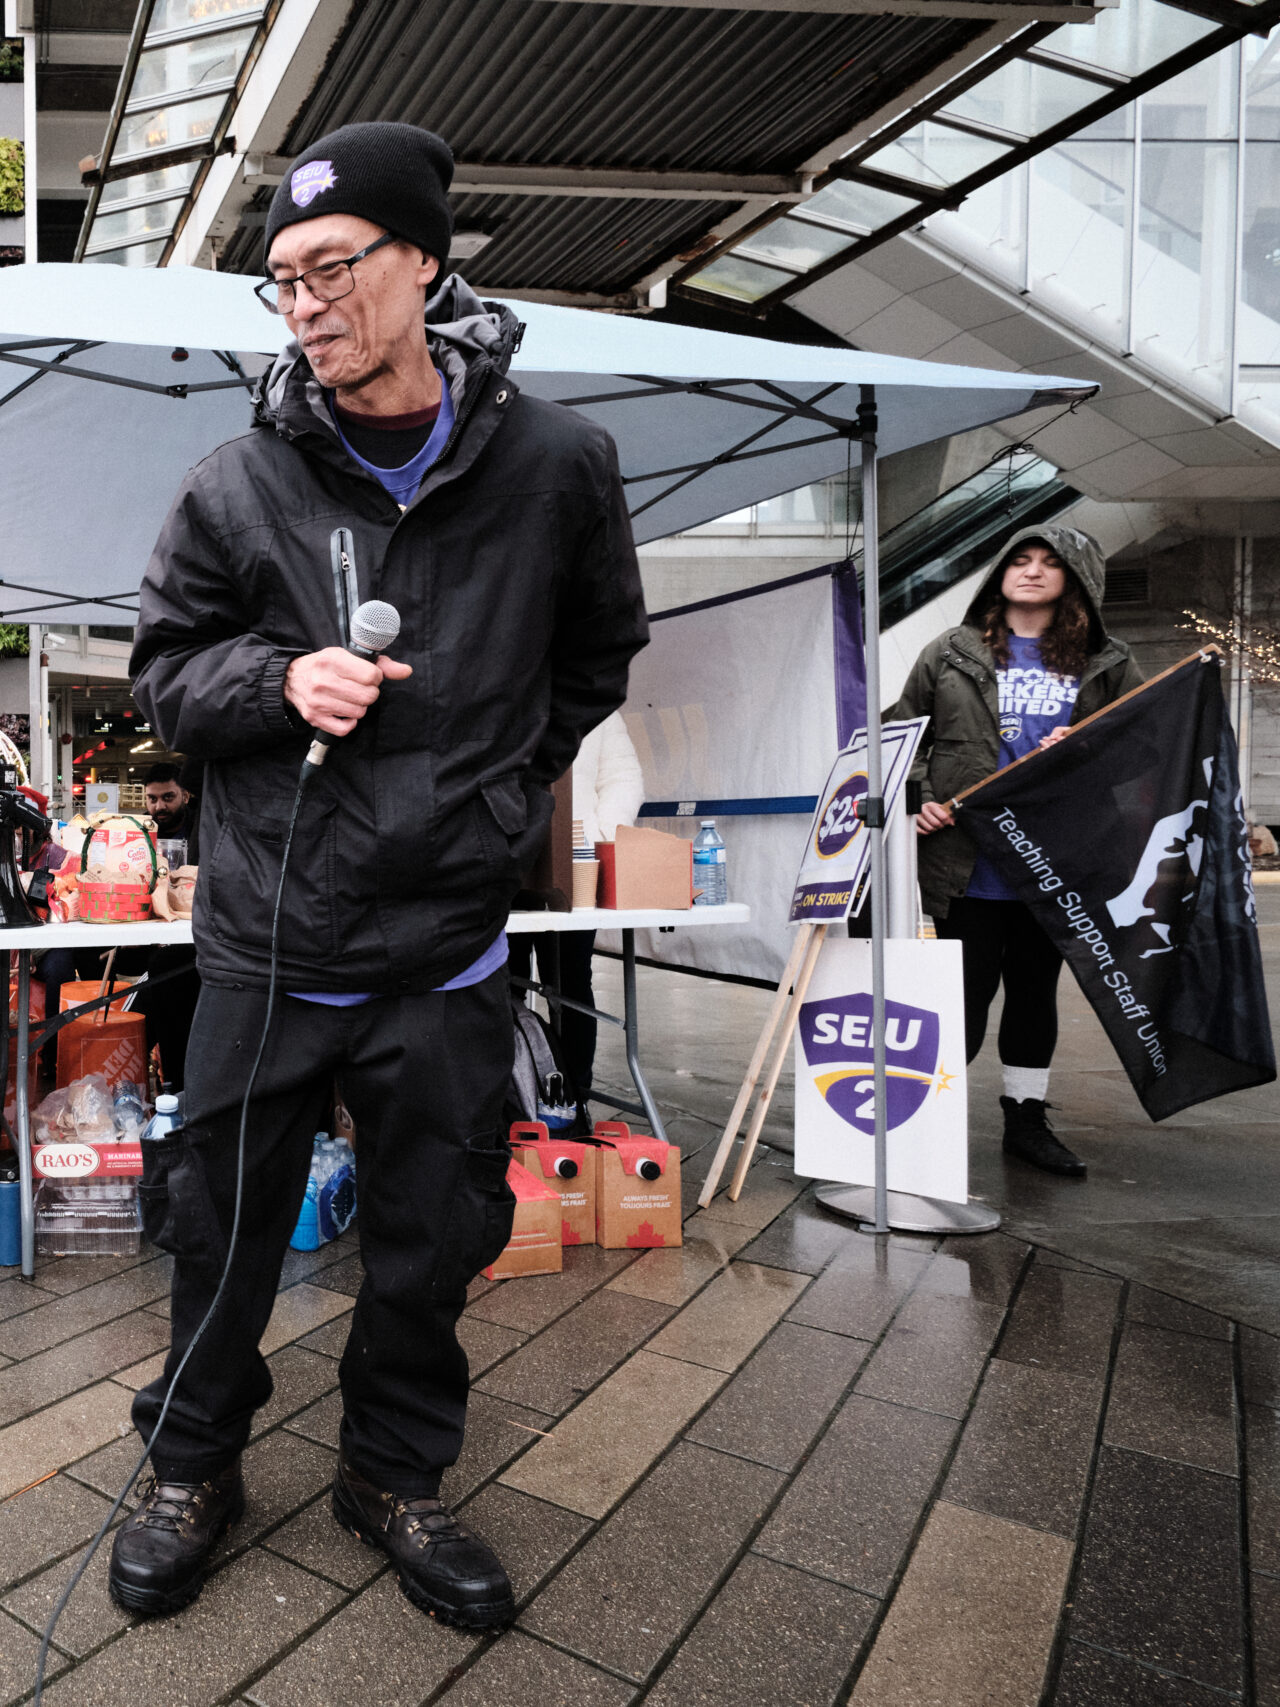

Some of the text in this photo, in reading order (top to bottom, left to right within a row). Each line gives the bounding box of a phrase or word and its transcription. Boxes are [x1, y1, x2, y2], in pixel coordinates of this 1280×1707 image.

[294, 164, 325, 183] SEIU
[300, 188, 310, 203] 2
[998, 683, 1079, 704] RKERS
[1006, 731, 1014, 739] 2
[802, 893, 817, 907] ON
[816, 891, 851, 906] STRIKE
[993, 806, 1168, 1077] Teaching Support Staff Union
[41, 1153, 93, 1168] RAO'S
